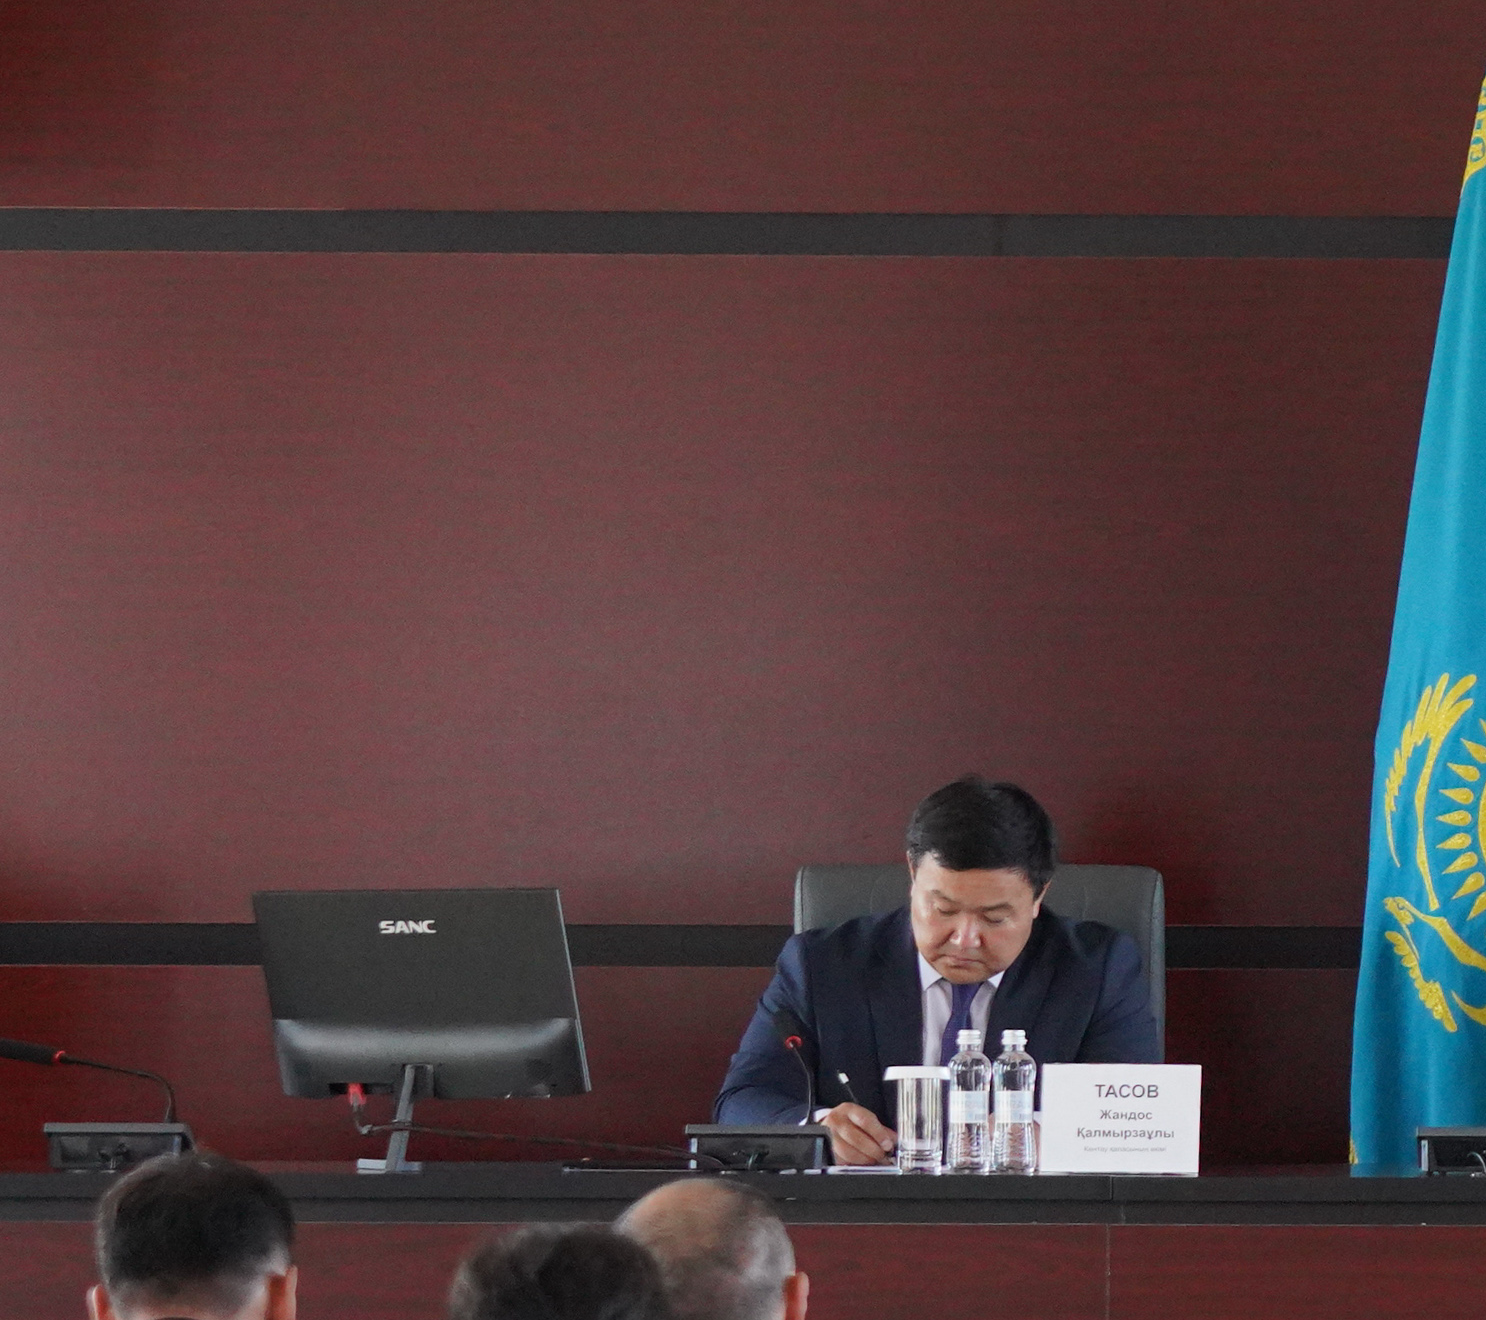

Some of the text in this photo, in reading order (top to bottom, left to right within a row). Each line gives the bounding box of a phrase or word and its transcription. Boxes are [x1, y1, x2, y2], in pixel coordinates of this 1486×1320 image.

[378, 919, 437, 934] SANC
[1095, 1084, 1159, 1099] ТАСОВ
[1099, 1109, 1153, 1121] Жандос
[1077, 1127, 1175, 1140] Қалмырзаұлы
